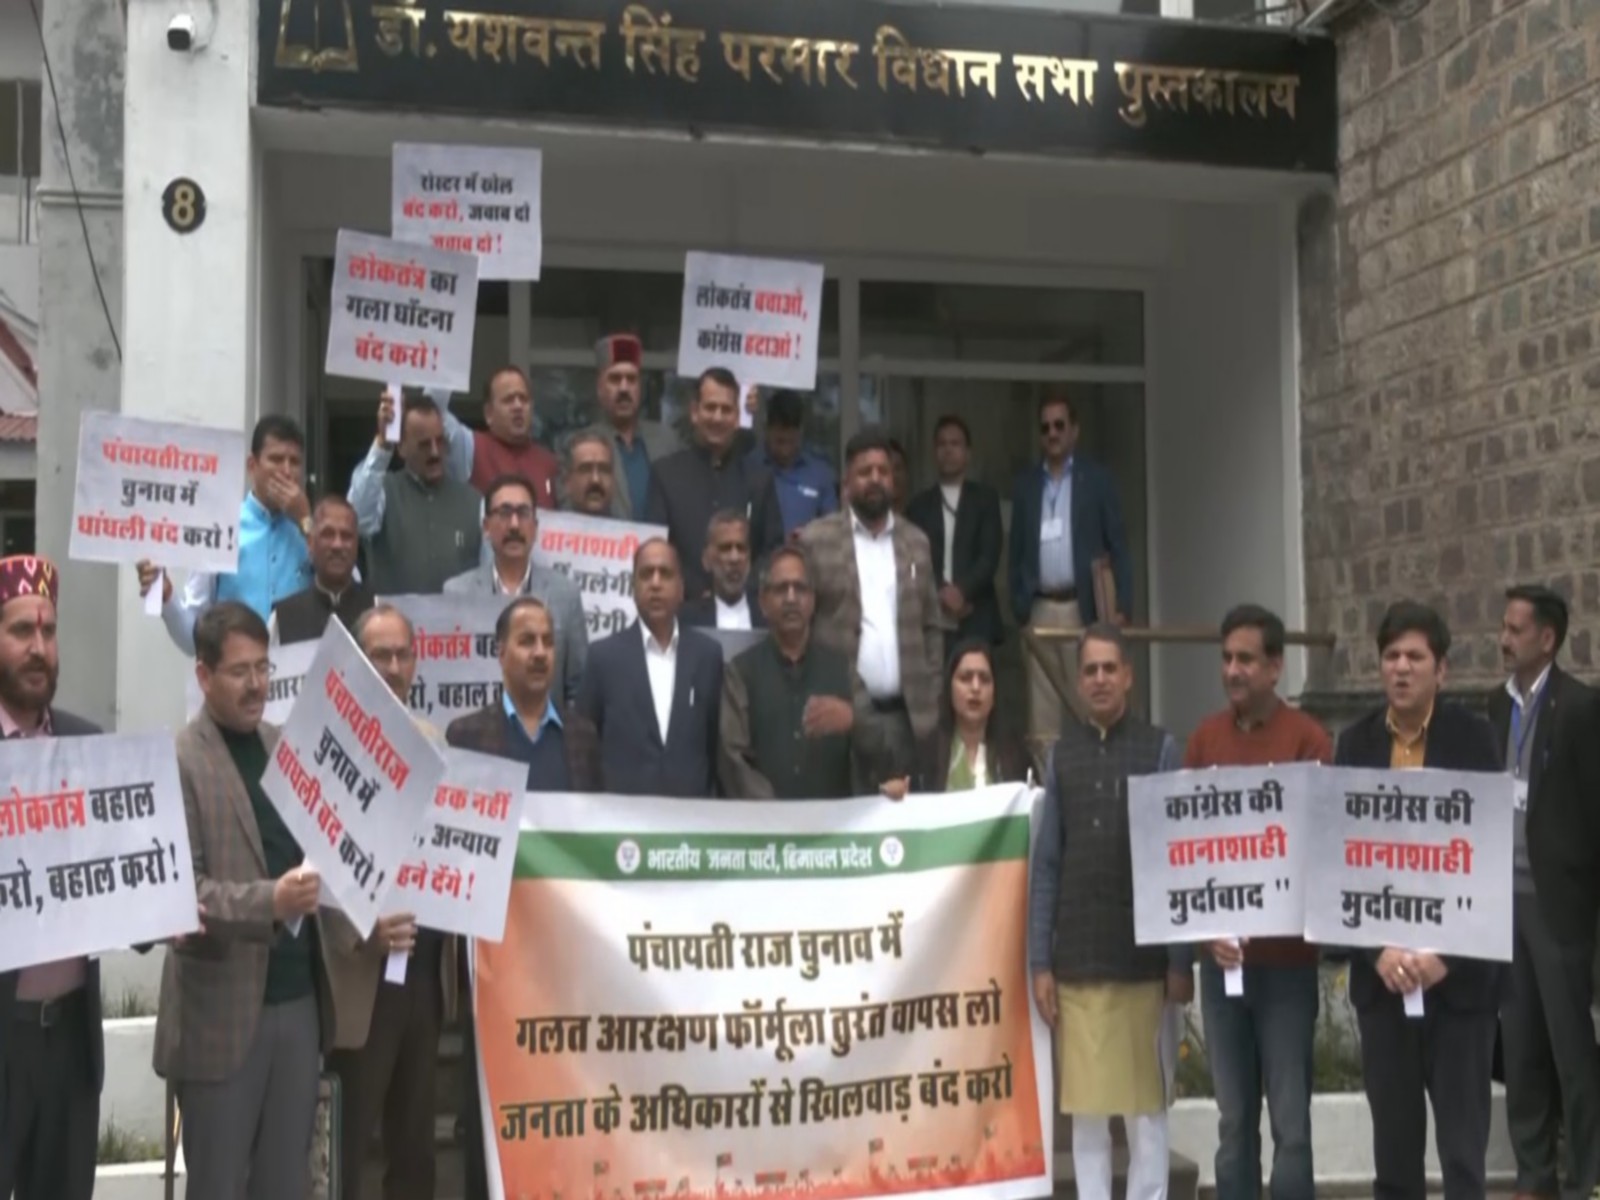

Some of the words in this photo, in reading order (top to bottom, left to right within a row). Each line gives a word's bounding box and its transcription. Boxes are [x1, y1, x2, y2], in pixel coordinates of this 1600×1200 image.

[443, 10, 605, 72] यशवन्त
[620, 4, 704, 82] सिंह
[720, 31, 859, 90] परमार
[872, 24, 1000, 98] विधान
[1013, 53, 1098, 106] सभा
[1114, 61, 1300, 127] पुस्तकालय
[172, 184, 195, 226] 8
[467, 203, 511, 222] जवाब
[514, 201, 531, 223] दो
[347, 251, 427, 292] लोकतंत्र
[430, 270, 459, 295] का
[346, 294, 391, 323] गला
[696, 279, 752, 313] लोकतंत्र
[354, 331, 386, 364] बंद
[696, 322, 743, 355] कांग्रेस
[101, 436, 220, 476] पंचायतीराज
[121, 477, 177, 507] चुनाव
[179, 479, 200, 506] में
[77, 509, 147, 543] धांधली
[150, 515, 179, 545] बंद
[182, 522, 223, 550] करो
[541, 530, 639, 560] तानाशाही
[585, 604, 628, 634] लेगी
[437, 681, 490, 708] बहाल
[323, 667, 411, 792] पंचायतीराज
[314, 725, 362, 796] चुनाव
[357, 777, 382, 814] में
[0, 779, 86, 838] लोकतंत्र
[89, 780, 155, 824] बहाल
[433, 784, 469, 811] हक
[1164, 784, 1243, 821] कांग्रेस
[1247, 779, 1285, 813] की
[1344, 783, 1431, 823] कांग्रेस
[1433, 788, 1475, 826] की
[317, 802, 344, 848] बंद
[339, 829, 375, 890] करो
[430, 823, 502, 860] अन्याय
[648, 842, 700, 871] भारतीय
[707, 849, 746, 870] जनता
[783, 842, 838, 871] हिमाचल
[840, 842, 873, 869] प्रदेश
[1166, 823, 1288, 868] तानाशाही
[1343, 837, 1475, 876] तानाशाही
[46, 857, 117, 902] बहाल
[118, 836, 167, 890] करो
[396, 860, 429, 891] हने
[431, 863, 463, 899] देंगे
[1166, 876, 1266, 926] मुर्दाबाद
[1340, 884, 1446, 929] मुर्दाबाद
[627, 921, 735, 971] पंचायती
[740, 931, 793, 968] राज
[798, 927, 874, 979] चुनाव
[877, 910, 905, 961] में
[516, 1013, 592, 1056] गलत
[596, 1011, 718, 1053] आरक्षण
[722, 997, 828, 1062] फॉर्मूला
[830, 991, 887, 1057] तुरंत
[890, 994, 960, 1036] वापस
[965, 977, 1004, 1027] लो
[499, 1097, 588, 1142] जनता
[592, 1083, 623, 1134] के
[629, 1077, 767, 1132] अधिकारों
[767, 1077, 796, 1127] से
[799, 1073, 913, 1124] खिलवाड़
[916, 1058, 961, 1108] बंद
[963, 1052, 1014, 1104] करो
